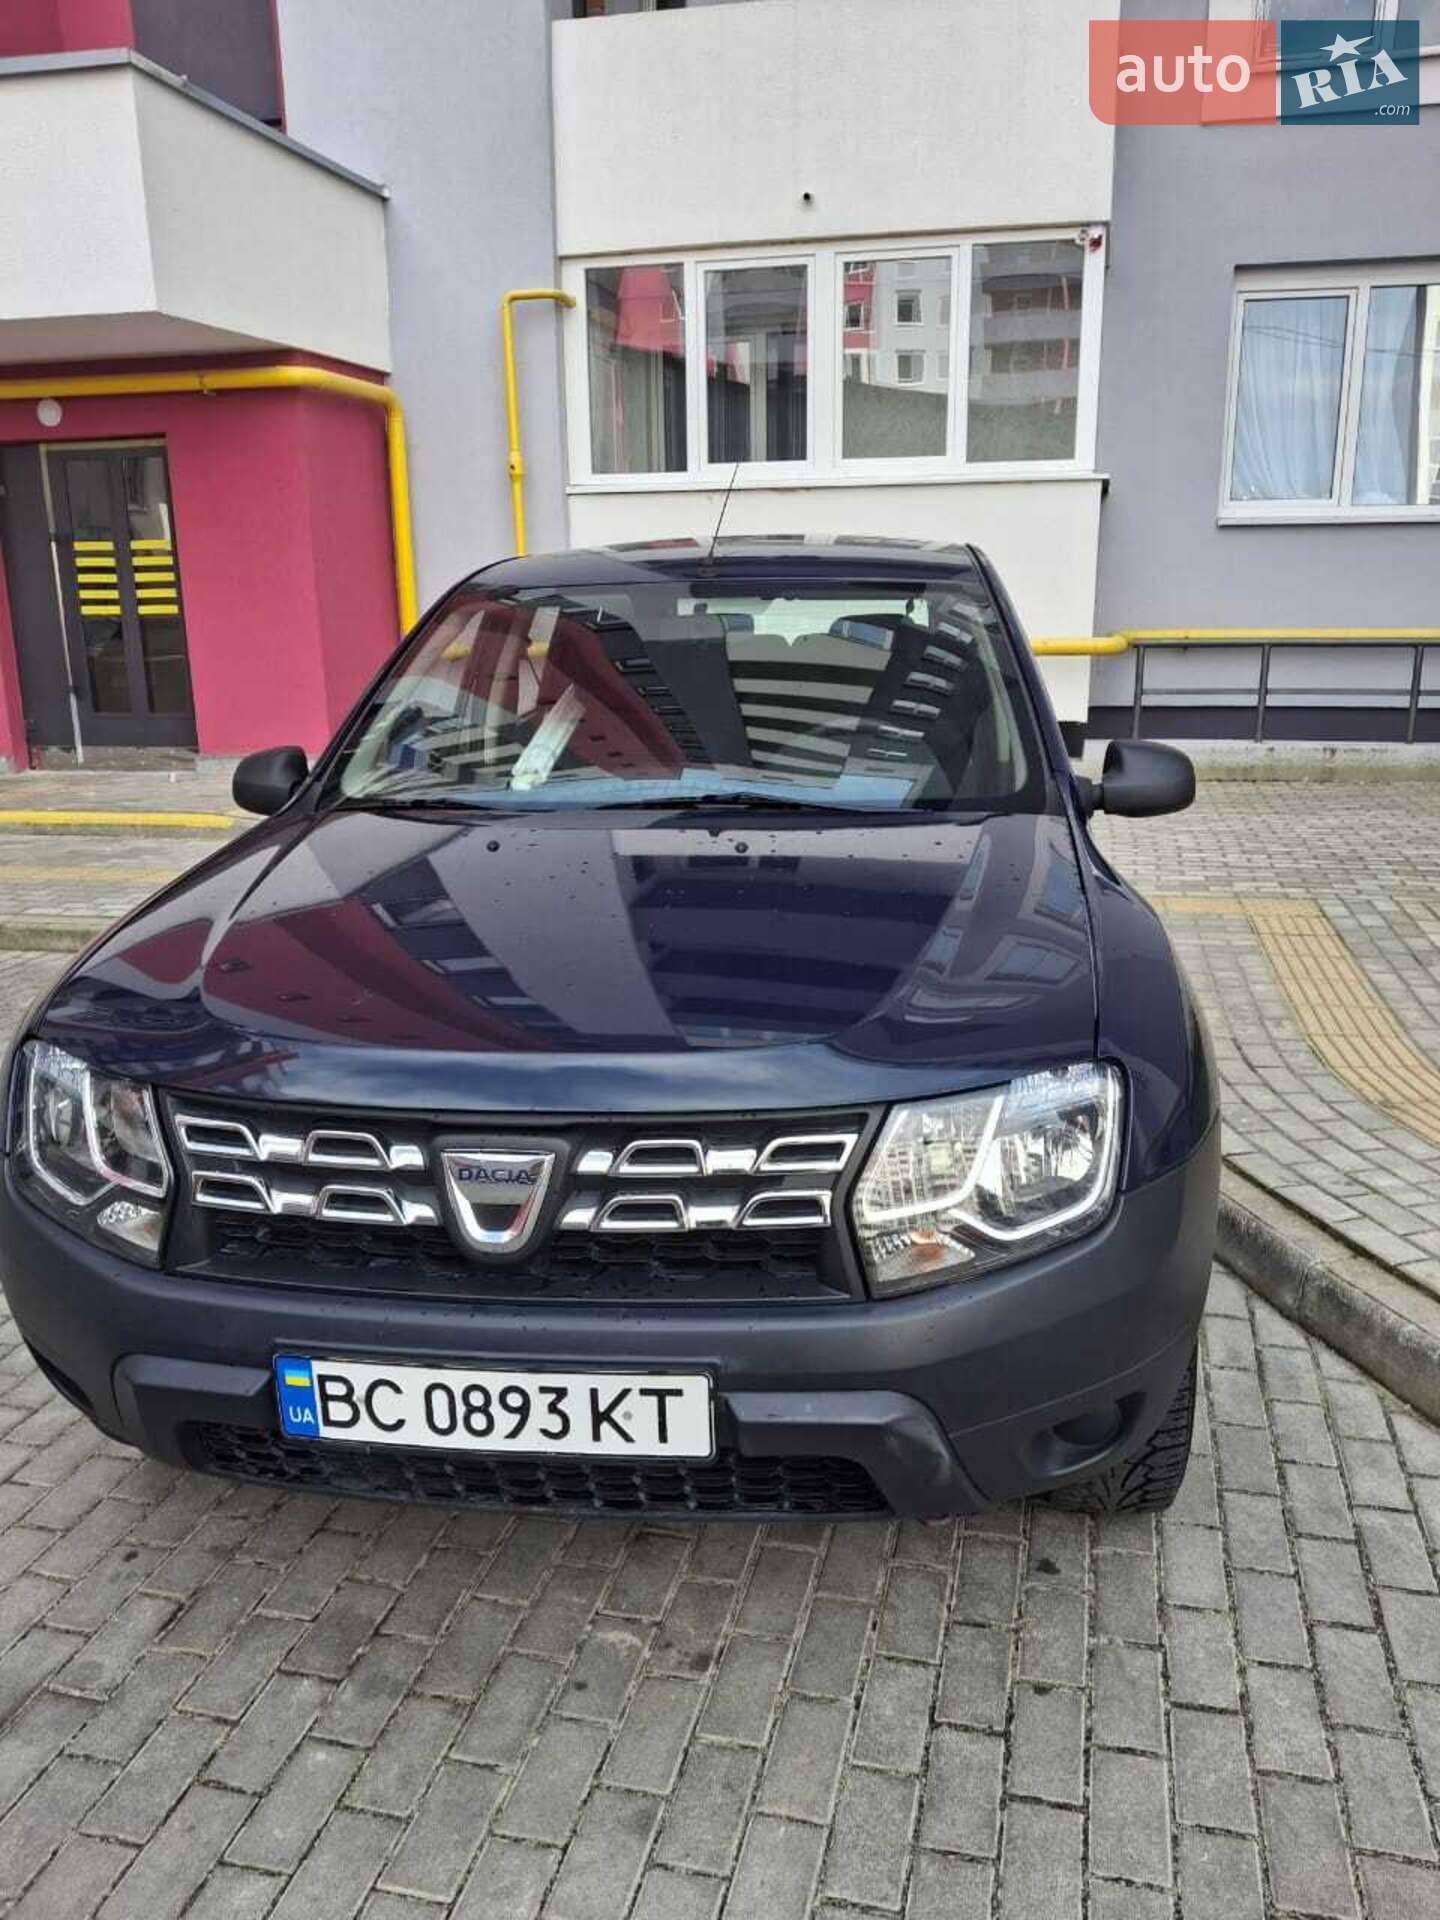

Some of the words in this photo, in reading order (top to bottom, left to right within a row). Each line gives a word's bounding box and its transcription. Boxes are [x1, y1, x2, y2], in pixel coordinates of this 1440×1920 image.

[457, 1166, 538, 1185] DACIA
[289, 1406, 315, 1424] UA
[317, 1373, 406, 1432] BC
[423, 1382, 571, 1441] 0893
[589, 1387, 684, 1443] KT
